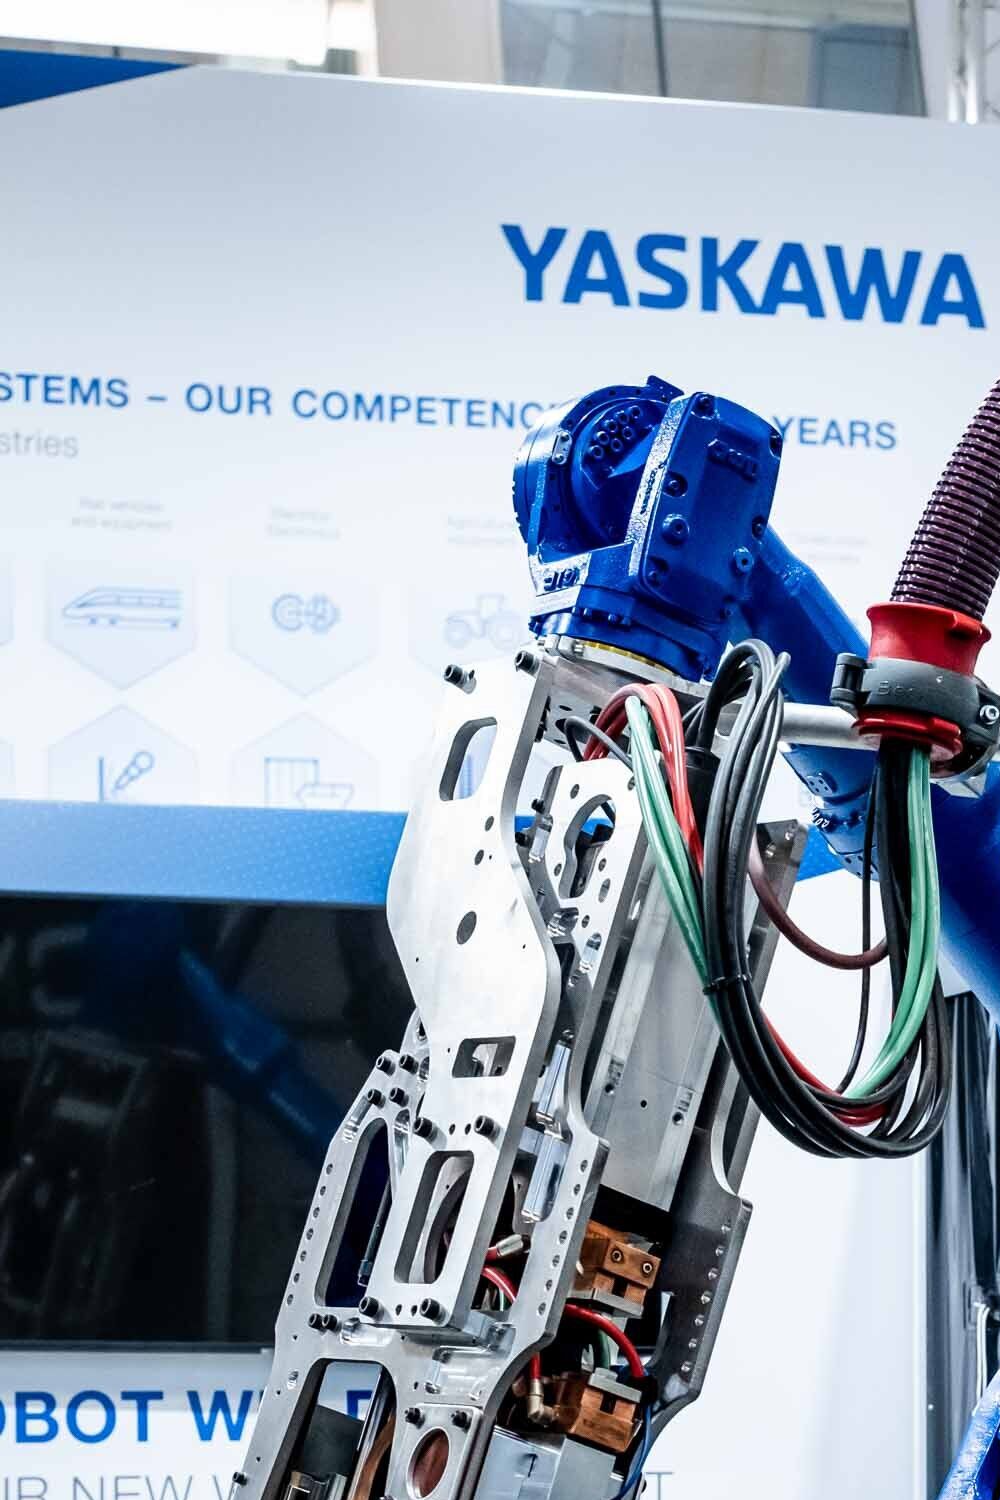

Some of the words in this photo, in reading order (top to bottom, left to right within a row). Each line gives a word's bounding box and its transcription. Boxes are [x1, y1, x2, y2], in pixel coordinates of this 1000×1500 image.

[500, 223, 986, 329] YASKAWA
[0, 371, 130, 408] STEMS
[185, 383, 272, 416] OUR
[291, 389, 558, 430] COMPETENC
[773, 415, 898, 450] YEARS
[0, 1390, 163, 1443] BOT
